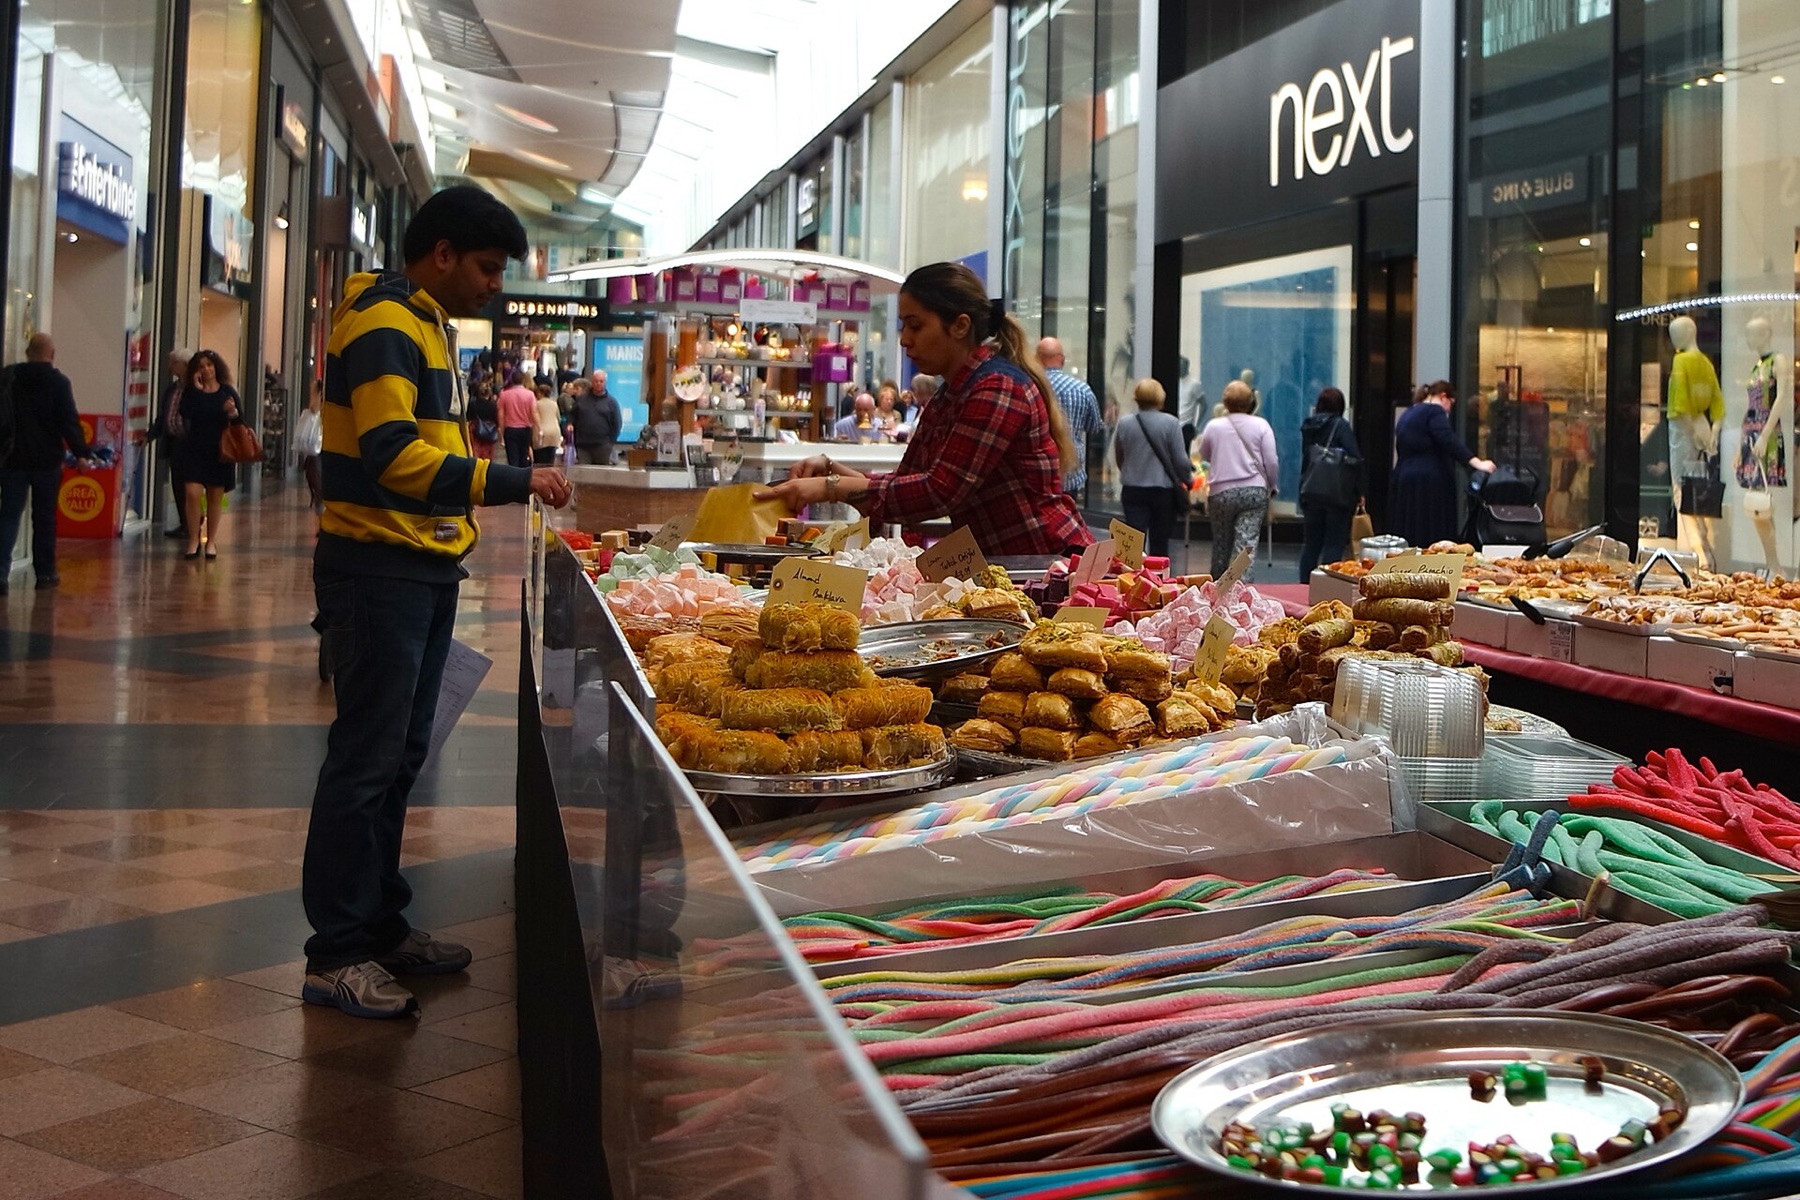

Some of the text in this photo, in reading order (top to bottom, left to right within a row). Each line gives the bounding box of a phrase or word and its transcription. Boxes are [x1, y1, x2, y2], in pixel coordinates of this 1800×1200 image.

[1270, 36, 1414, 187] next
[507, 301, 598, 318] DEBENHMS
[64, 487, 98, 498] GREA
[812, 588, 847, 603] Baklava
